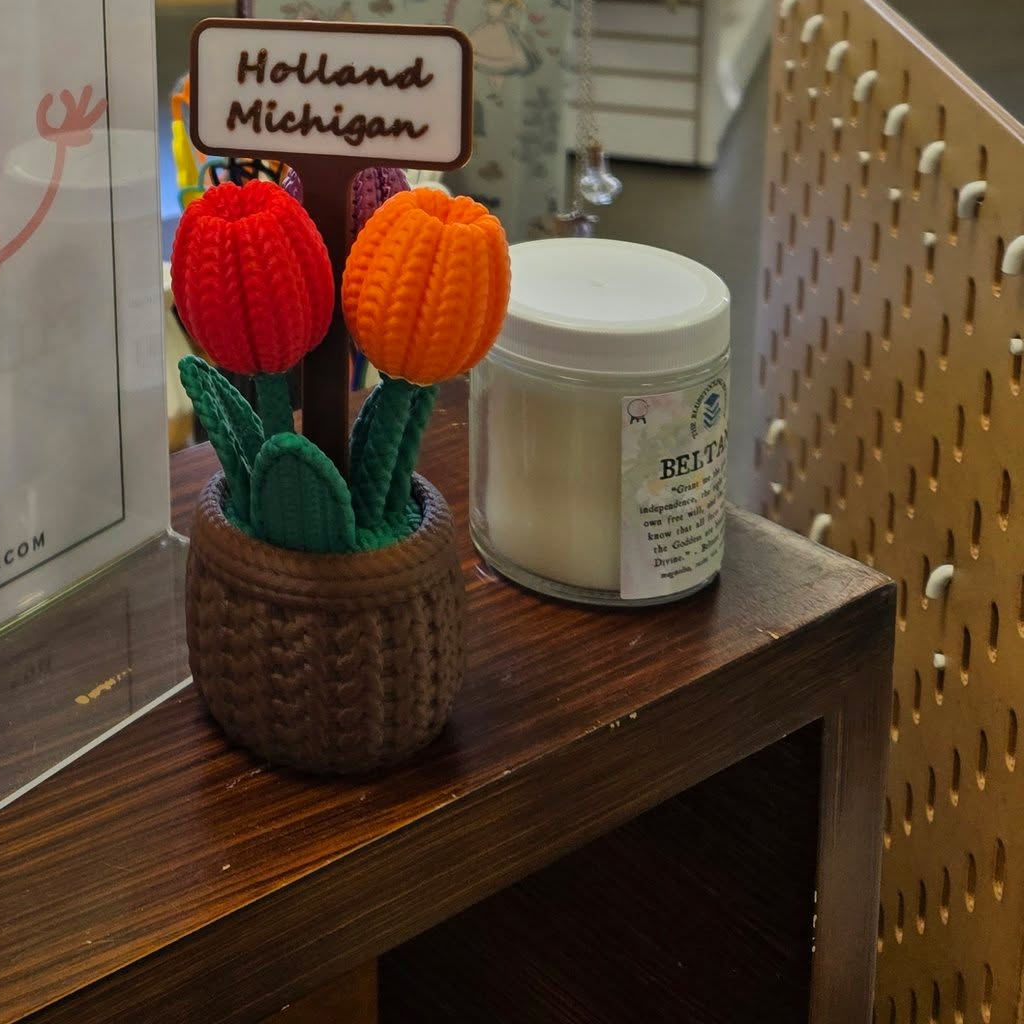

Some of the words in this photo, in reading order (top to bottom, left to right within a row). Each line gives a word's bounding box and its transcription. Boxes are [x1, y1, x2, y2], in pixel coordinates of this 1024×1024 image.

[236, 47, 434, 90] Holland
[225, 98, 430, 147] Michigan
[639, 497, 698, 514] independence,
[643, 519, 662, 528] own
[667, 514, 684, 525] free
[647, 531, 672, 541] know
[676, 525, 692, 535] that
[653, 544, 668, 554] the
